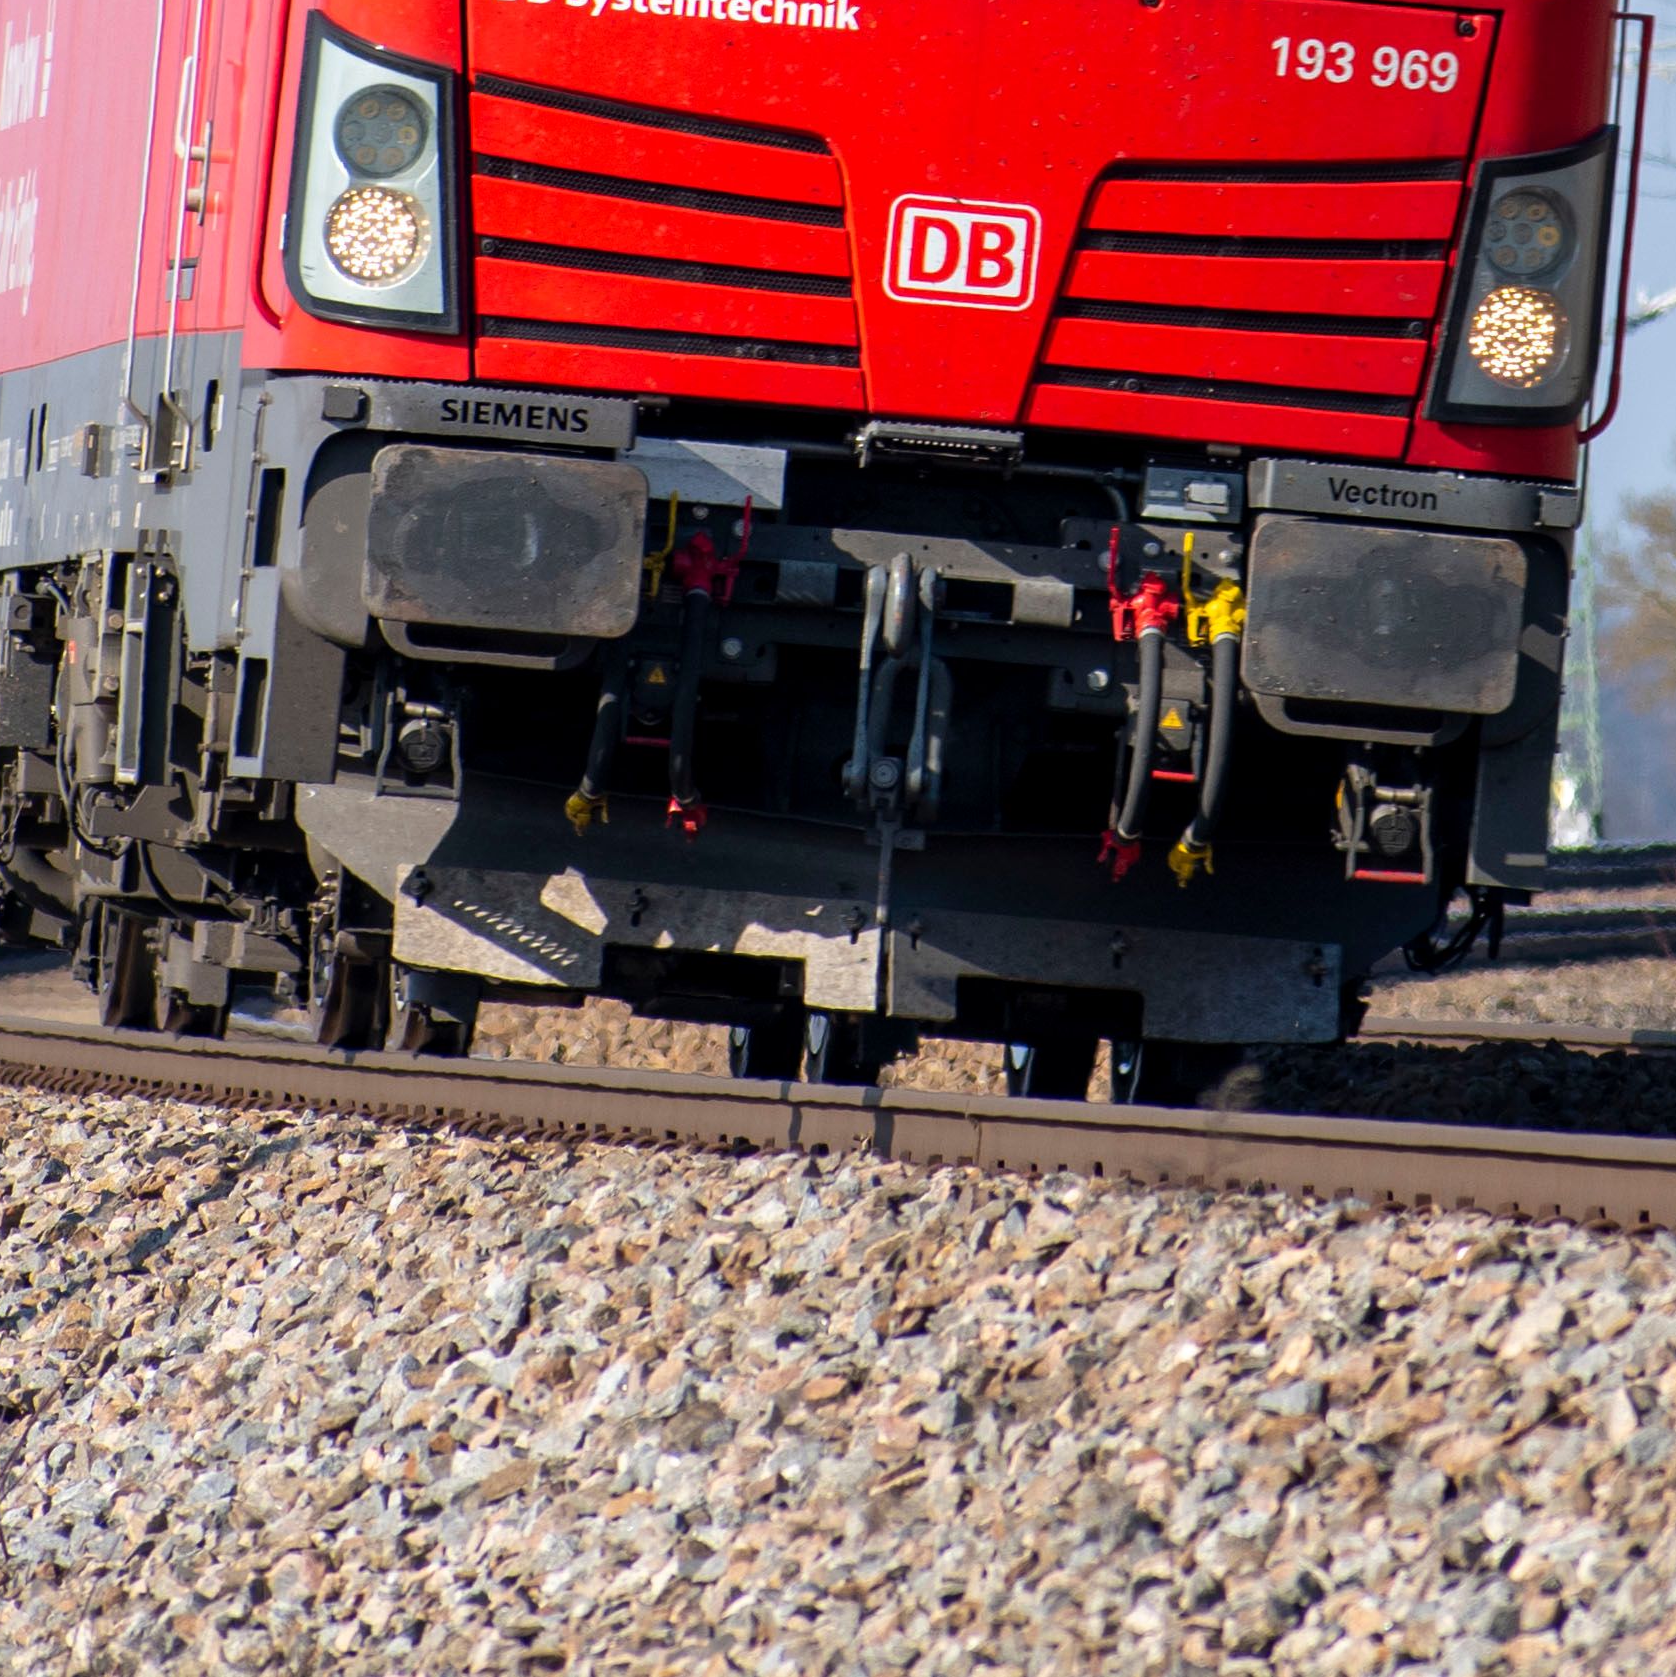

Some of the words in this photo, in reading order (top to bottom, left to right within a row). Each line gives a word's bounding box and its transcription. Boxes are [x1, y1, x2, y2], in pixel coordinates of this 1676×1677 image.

[1270, 36, 1355, 84] 193
[1370, 45, 1459, 94] 969
[907, 216, 1017, 290] DB
[440, 398, 589, 433] SIEMENS
[1327, 476, 1439, 512] Vectron
